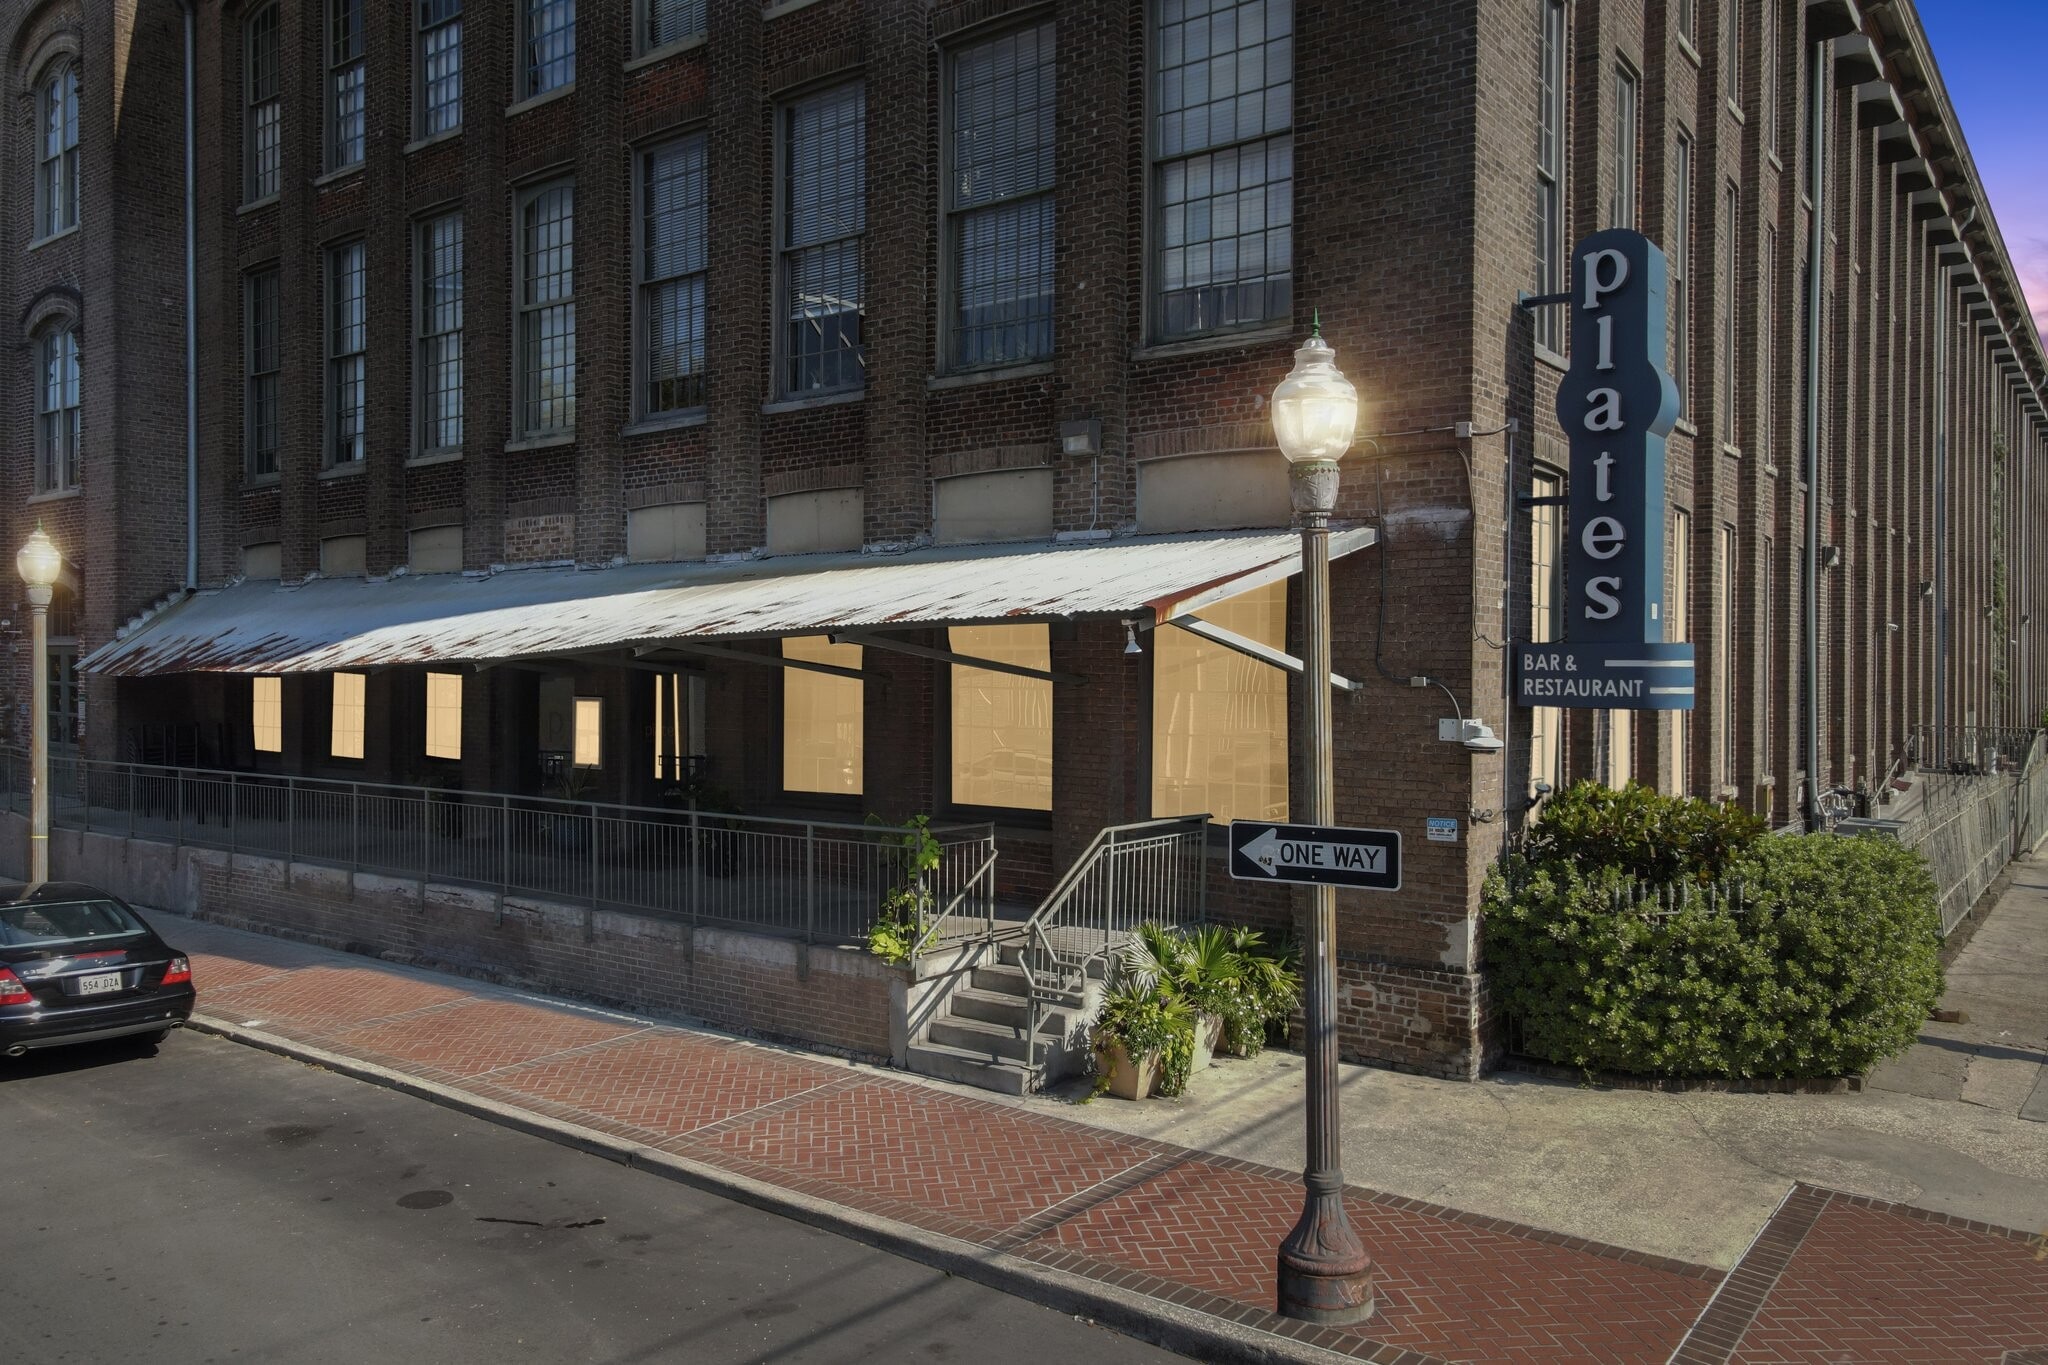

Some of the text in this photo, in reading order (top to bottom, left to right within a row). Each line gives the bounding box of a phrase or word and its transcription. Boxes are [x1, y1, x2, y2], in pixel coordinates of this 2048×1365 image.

[1581, 248, 1630, 620] plates
[1523, 653, 1578, 671] BAR &
[1523, 678, 1644, 698] RESTAURANT
[1428, 820, 1456, 828] NOTICE
[1280, 842, 1324, 866] ONE
[1333, 846, 1380, 870] WAY
